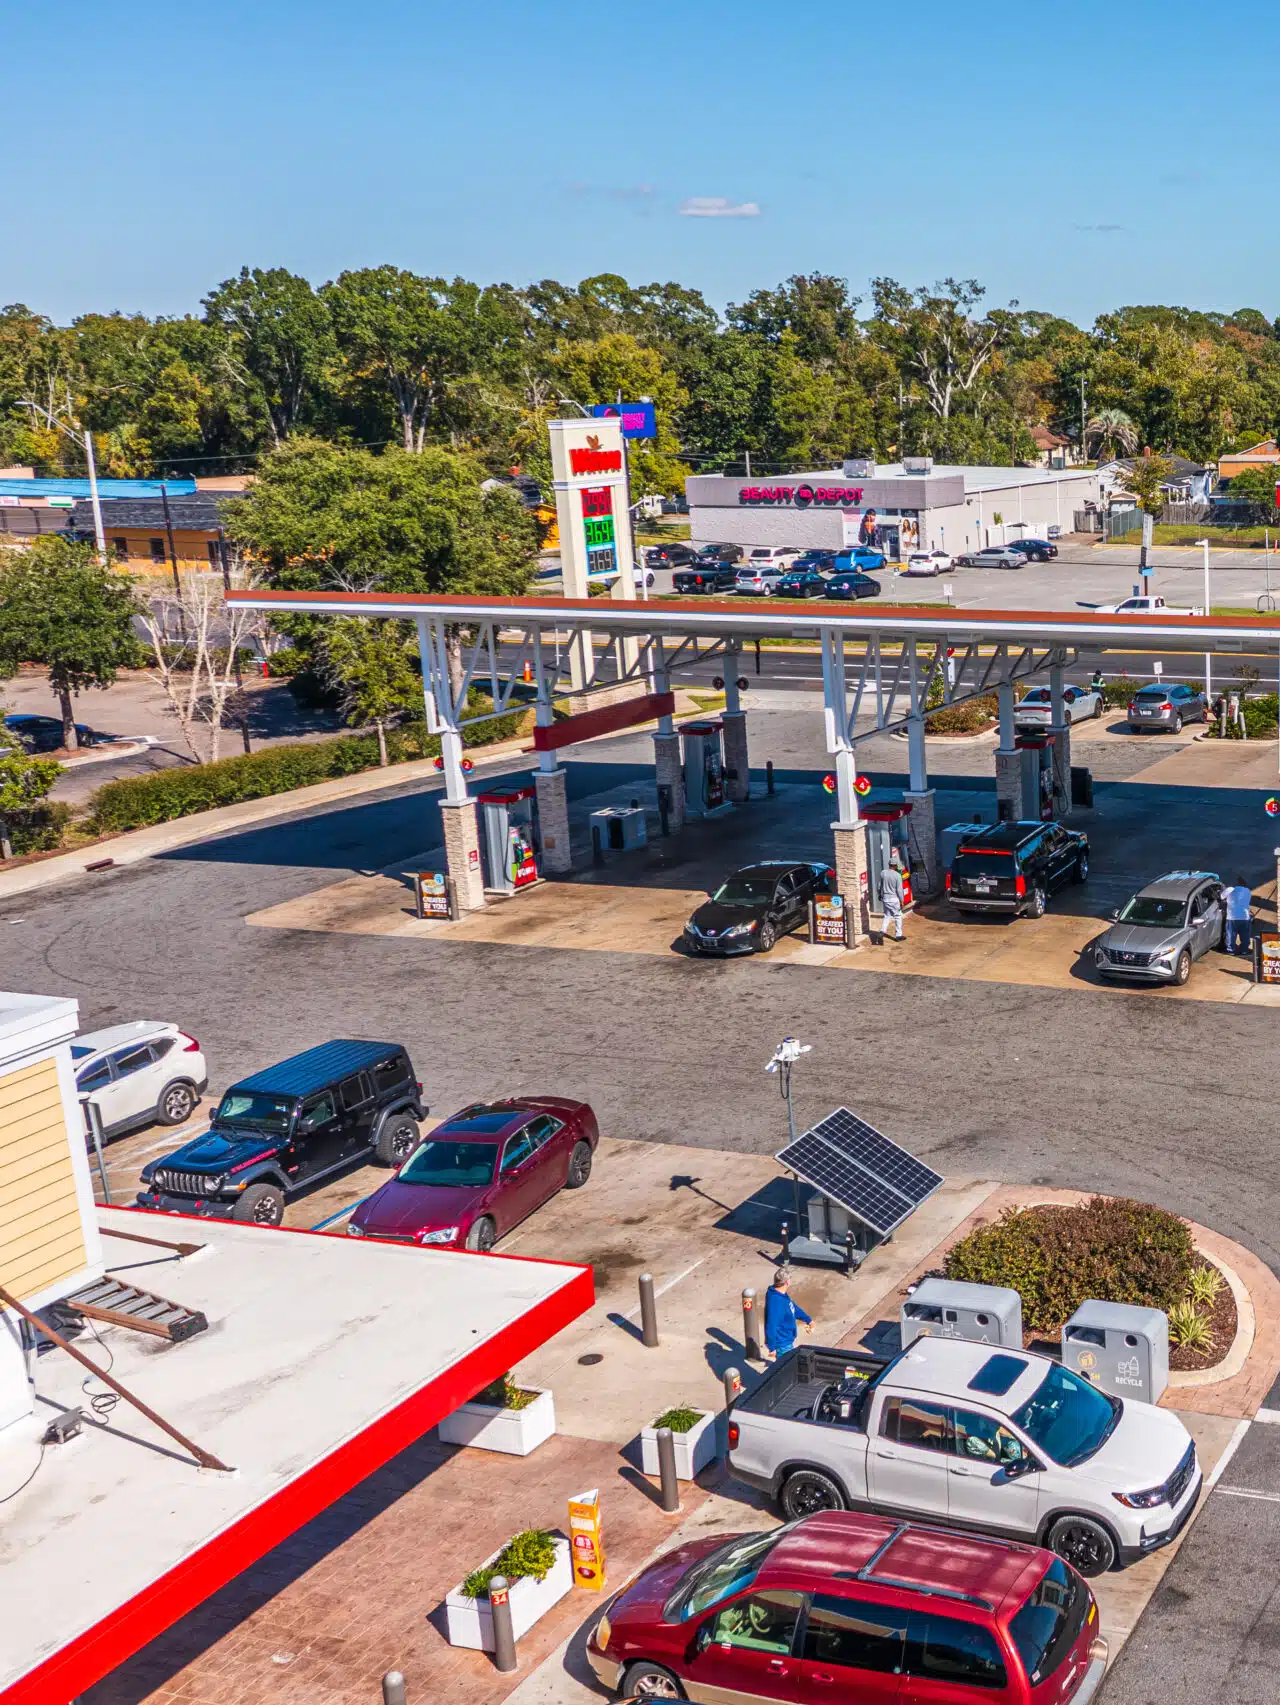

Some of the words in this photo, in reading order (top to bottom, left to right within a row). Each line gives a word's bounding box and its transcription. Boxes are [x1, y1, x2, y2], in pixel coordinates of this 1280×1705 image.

[741, 487, 795, 500] BEAUTY
[817, 488, 864, 500] DEPOT
[817, 920, 843, 928] CREATED
[827, 927, 843, 935] YOU
[1264, 966, 1273, 974] BY
[1115, 1376, 1143, 1387] RECYCLE
